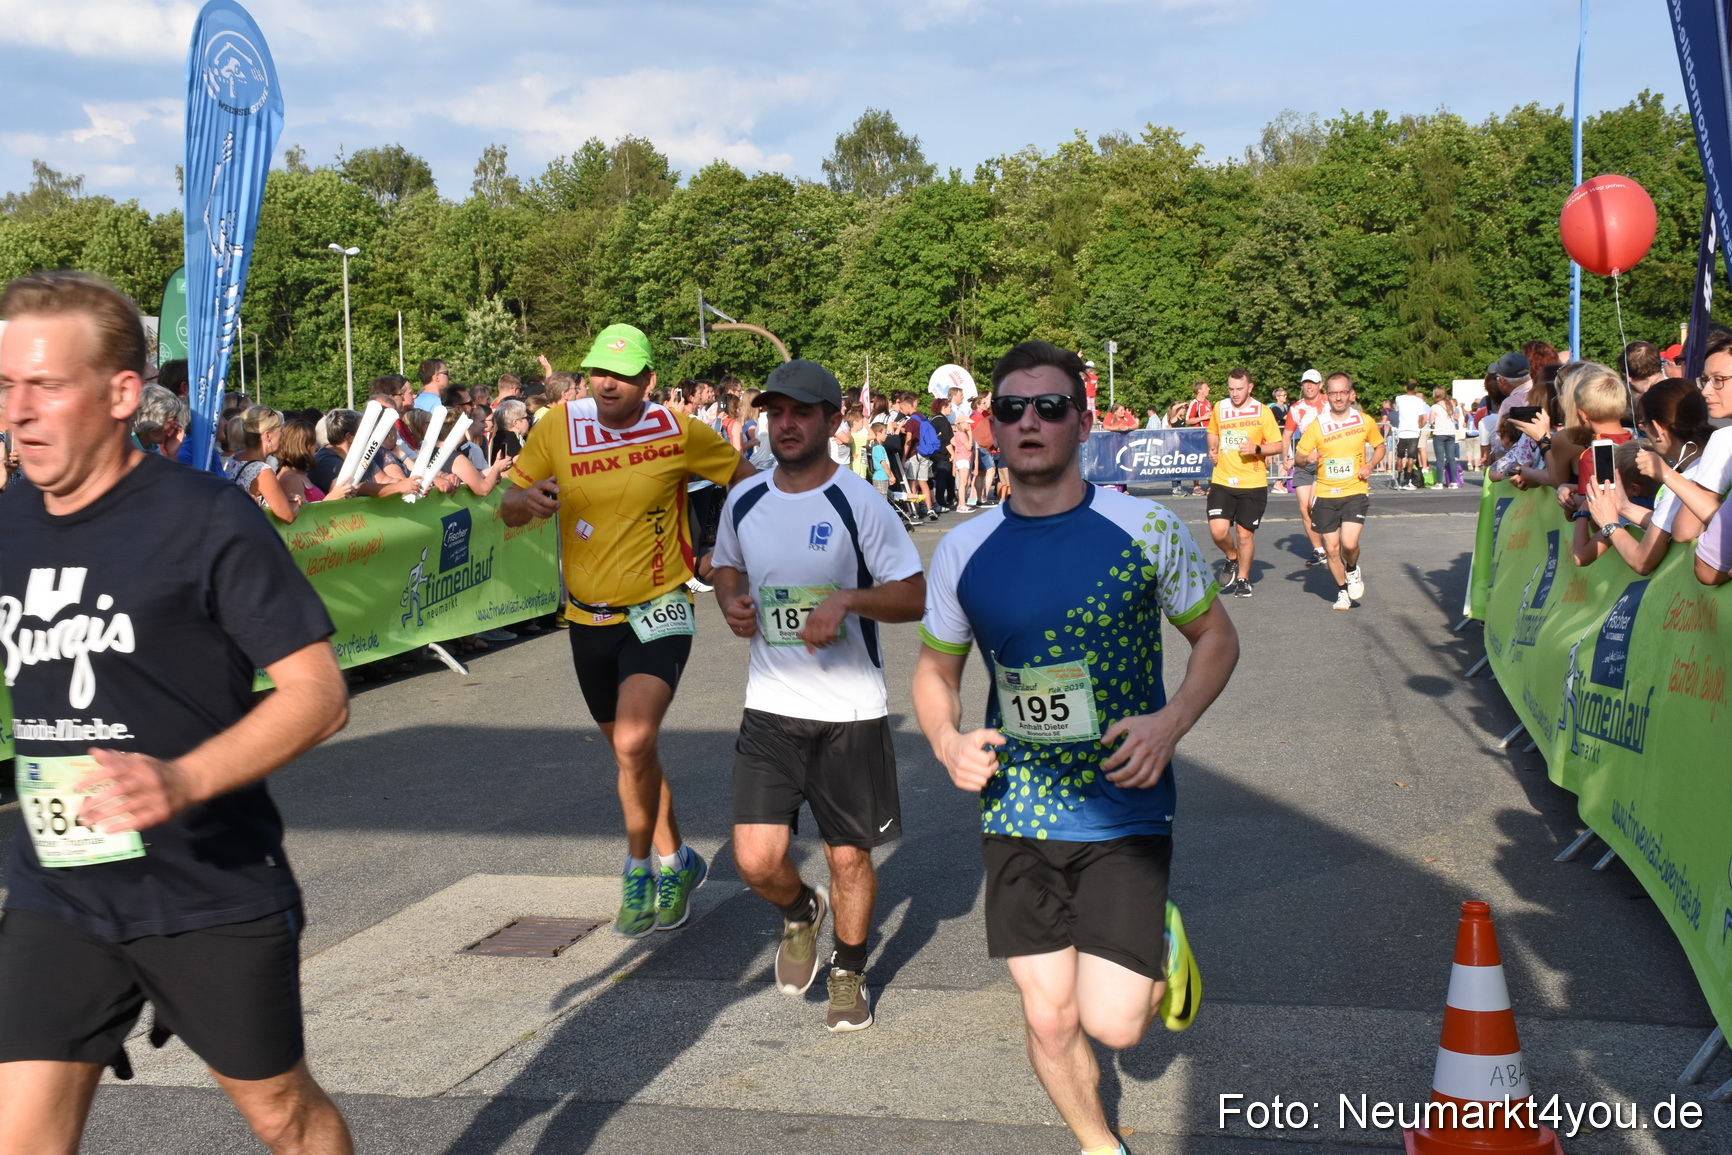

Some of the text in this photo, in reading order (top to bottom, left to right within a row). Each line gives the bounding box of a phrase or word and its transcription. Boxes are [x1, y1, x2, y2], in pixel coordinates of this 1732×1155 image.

[1220, 420, 1262, 430] MAX BÖGL
[1323, 427, 1366, 444] MAX BÖGL
[1224, 436, 1244, 445] 1657
[570, 443, 685, 478] MAX BÖGL
[1132, 450, 1207, 467] Fischer
[1139, 466, 1201, 475] AUTOMOBILE
[1328, 465, 1351, 474] 1644
[286, 519, 335, 553] Gesunde
[306, 529, 386, 577] laufen länger!
[424, 546, 494, 607] firmenlauf
[426, 597, 459, 620] neumarkt
[641, 603, 687, 628] 1669
[1606, 610, 1631, 629] Fischer
[1012, 694, 1070, 723] 195
[1019, 722, 1069, 731] Anhalt Dieter
[30, 798, 94, 836] 38
